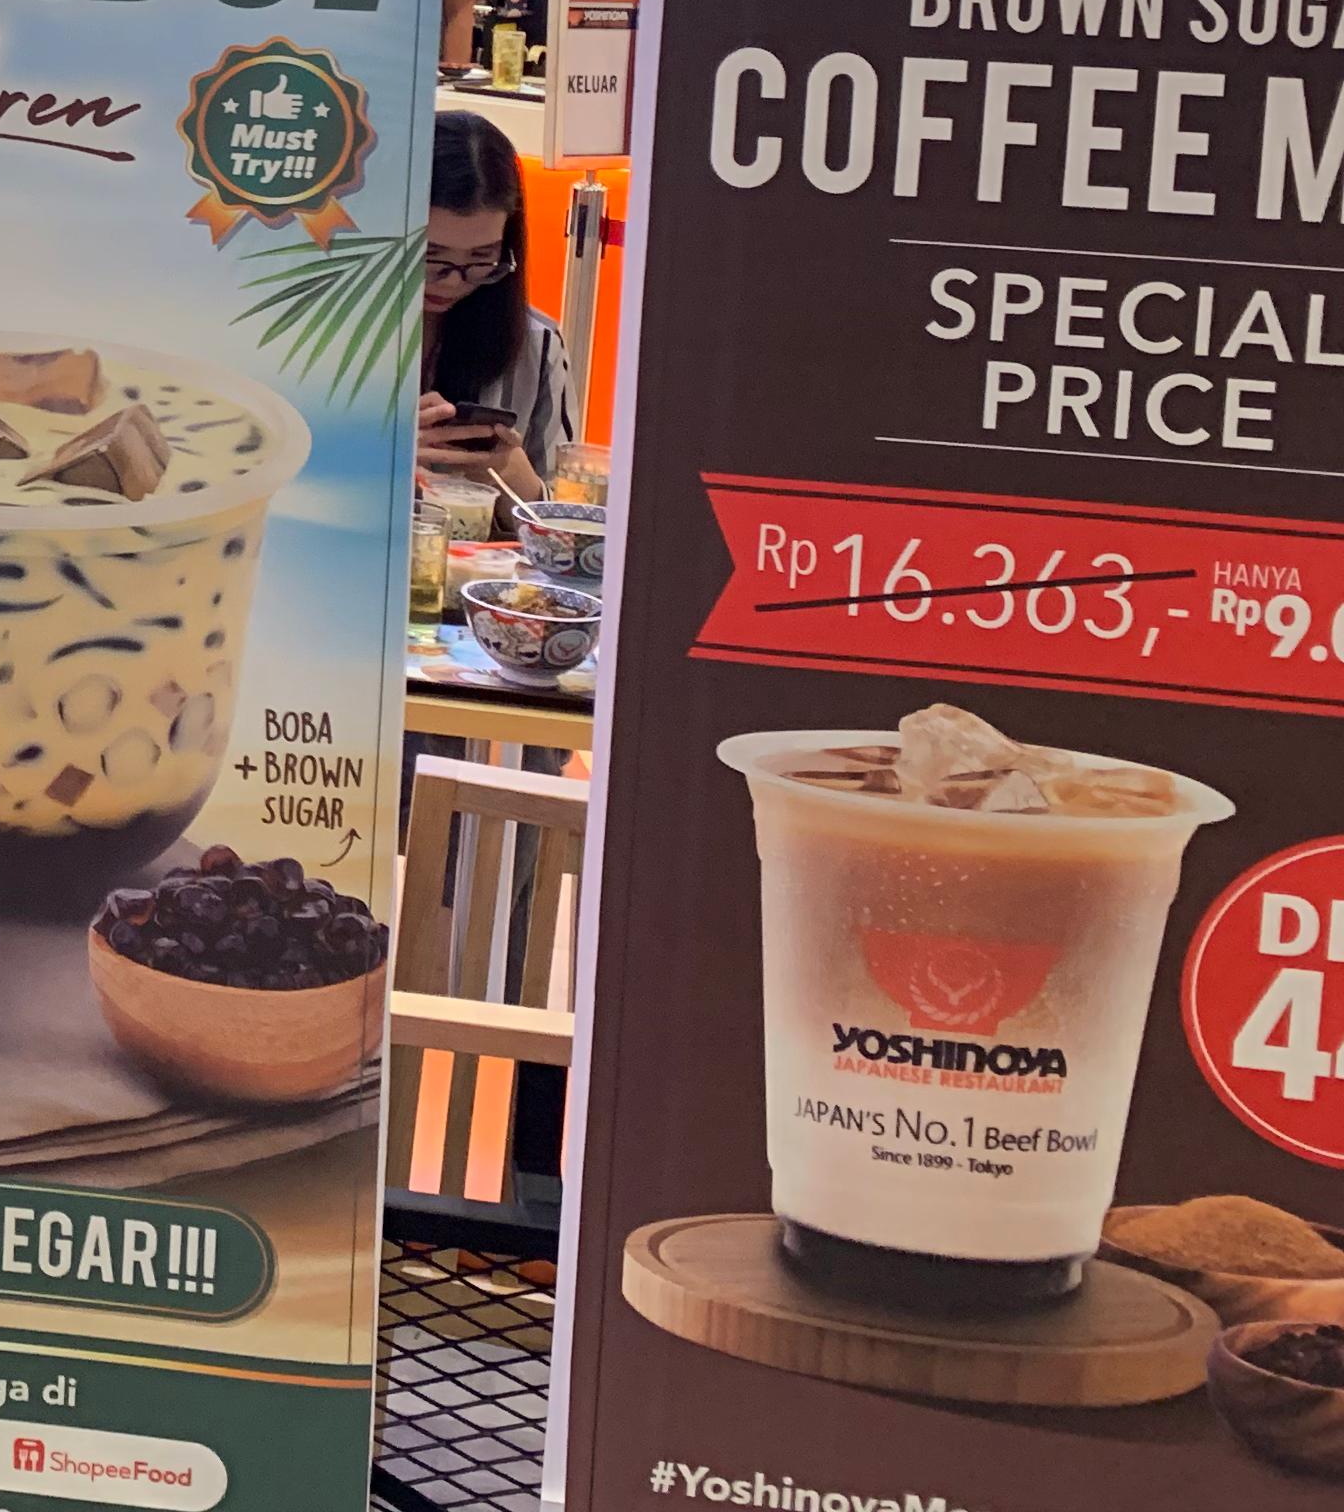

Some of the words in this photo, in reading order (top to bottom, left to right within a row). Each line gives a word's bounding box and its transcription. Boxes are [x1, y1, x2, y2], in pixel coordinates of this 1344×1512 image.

[567, 74, 618, 94] KELUAR
[230, 122, 318, 152] Must
[710, 46, 1227, 217] COFFEE
[230, 153, 318, 185] Try!!!
[924, 268, 1344, 368] SPECIAL
[981, 360, 1278, 452] PRICE
[755, 523, 819, 592] Rp
[264, 707, 333, 745] BOBA
[264, 750, 364, 789] BROWN
[260, 794, 345, 830] SUGAR
[832, 1022, 1068, 1078] YOSHINOYA
[832, 1055, 933, 1086] JAPANESE
[939, 1071, 1065, 1094] RESTAURANT
[793, 1095, 886, 1137] JAPAN'S
[984, 1125, 1043, 1152] Beef
[1047, 1127, 1098, 1153] Bowl
[41, 1374, 78, 1409] di
[48, 1447, 194, 1488] ShopeeFood
